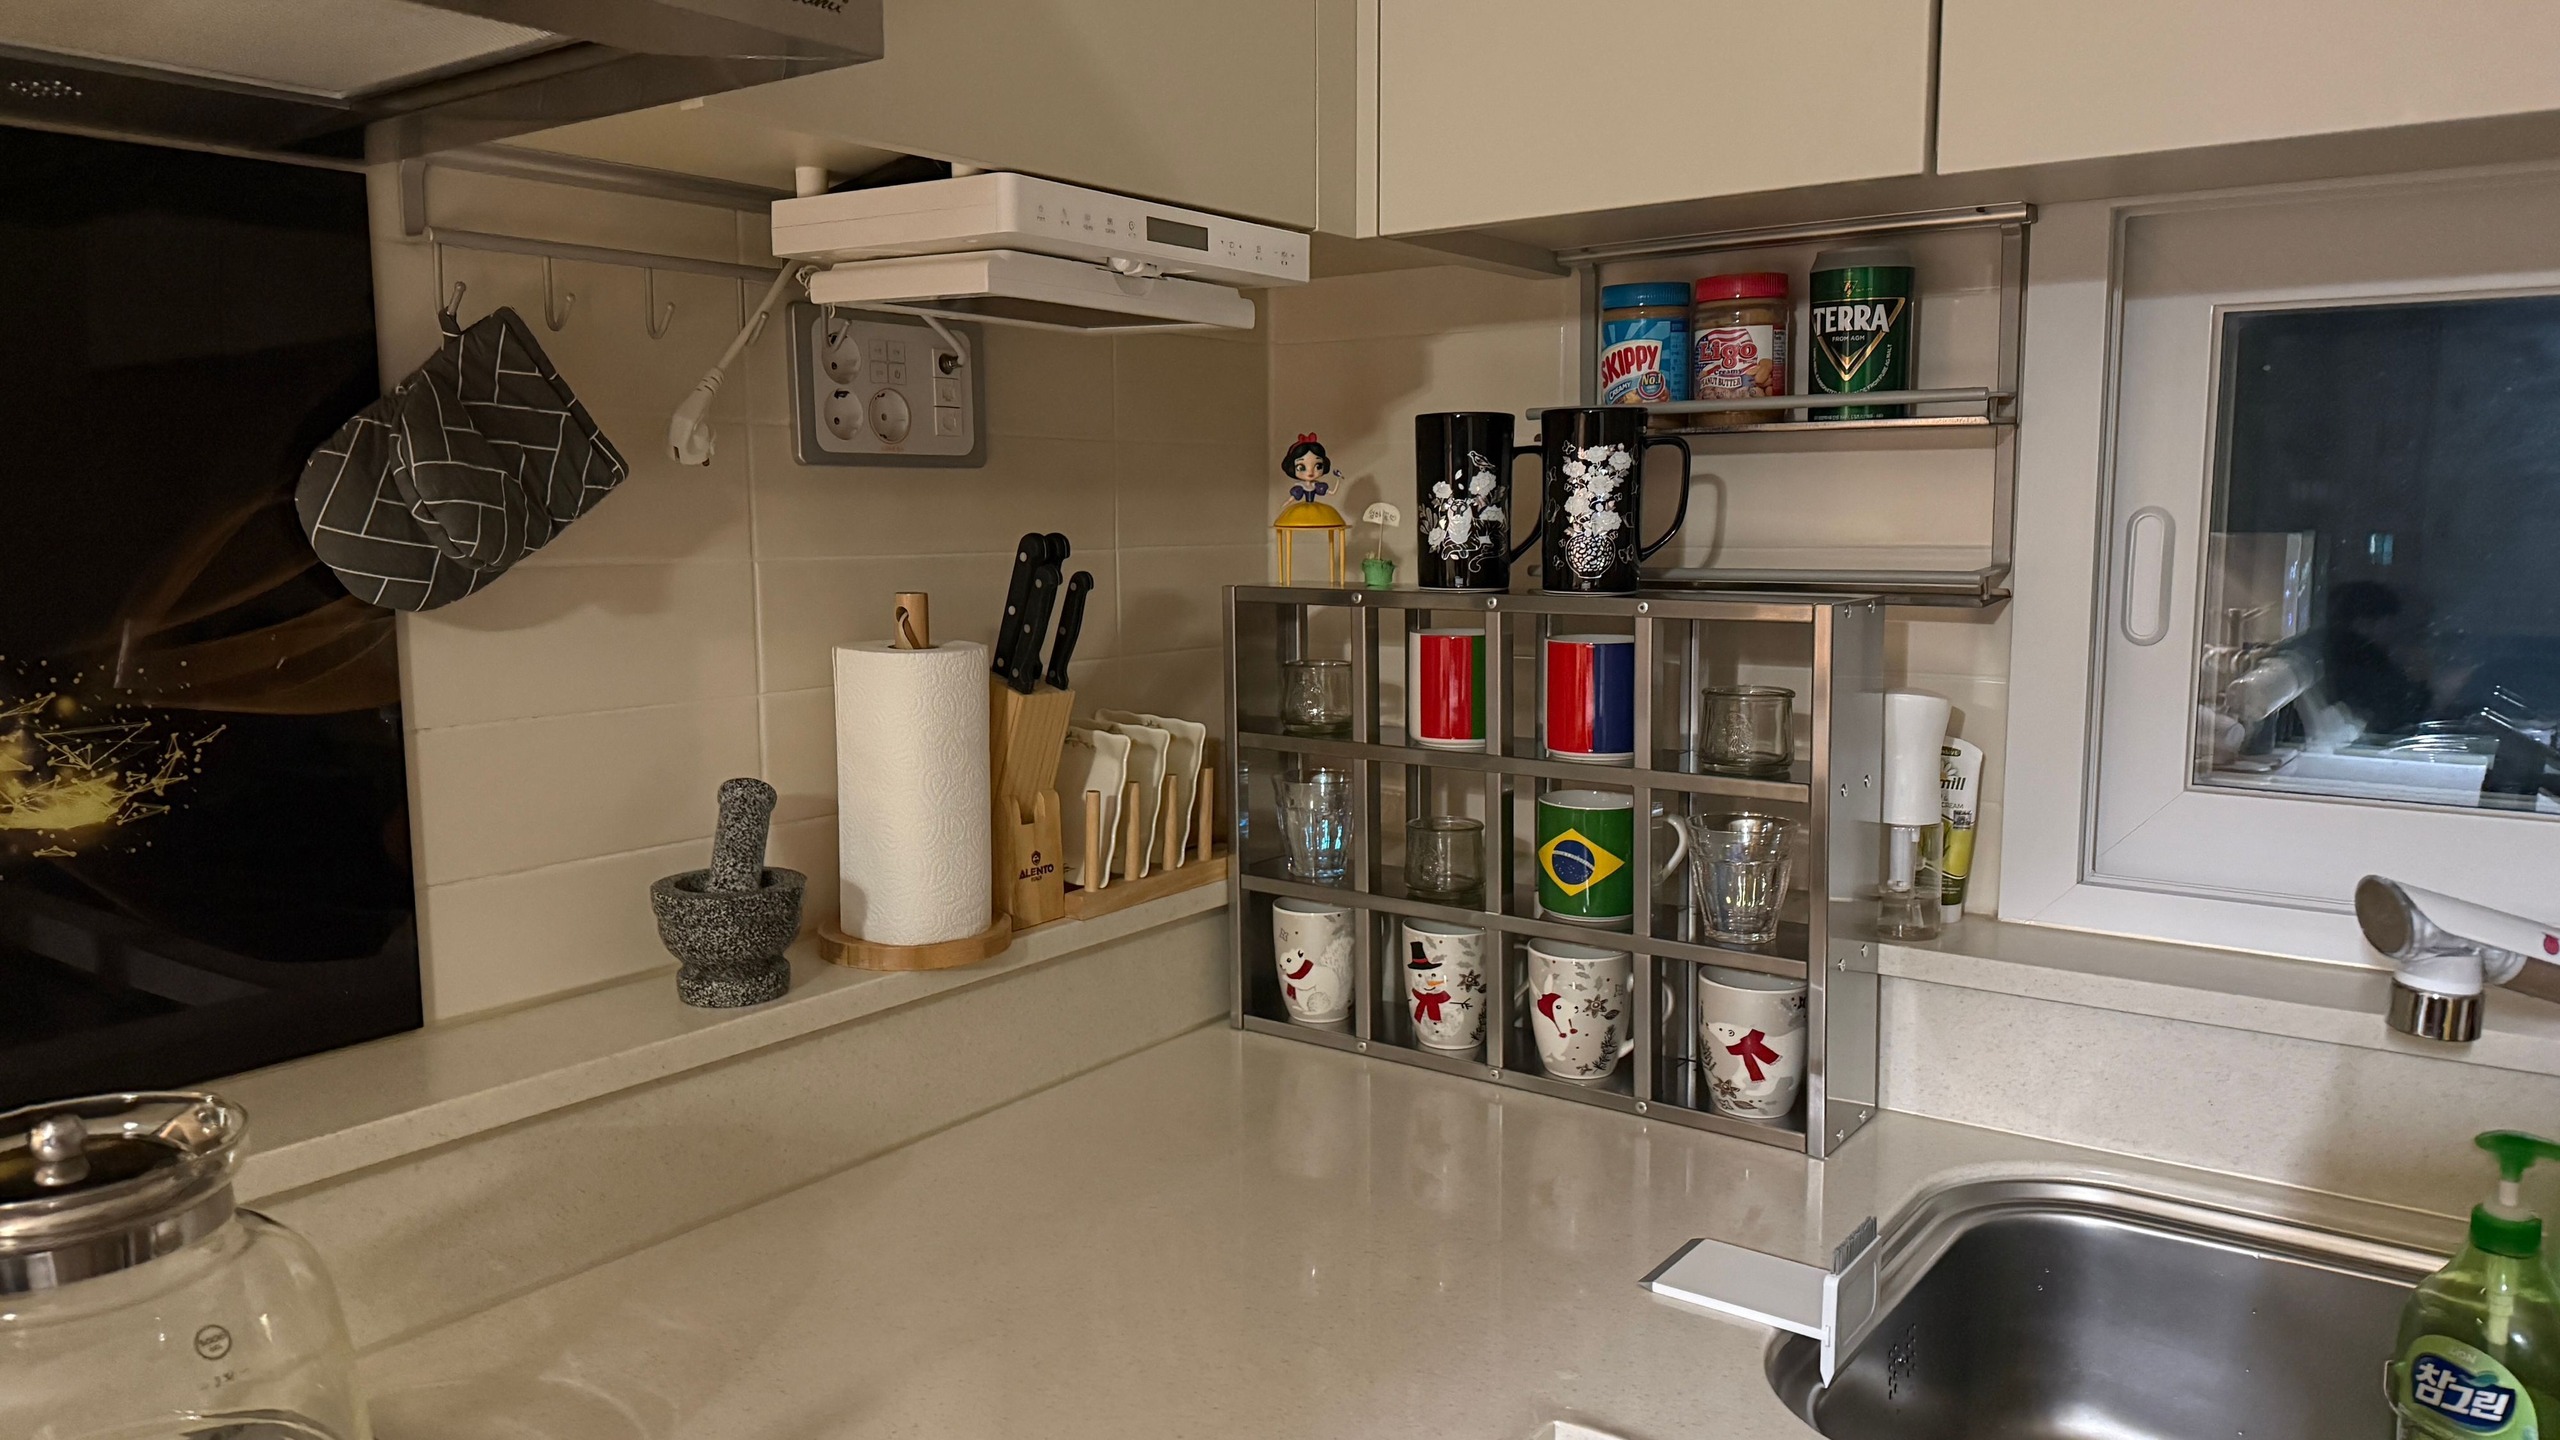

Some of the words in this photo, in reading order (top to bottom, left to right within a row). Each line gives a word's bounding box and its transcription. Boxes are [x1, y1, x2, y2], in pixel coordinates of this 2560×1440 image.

[1813, 303, 1890, 336] TERRA
[1700, 339, 1758, 370] Ligo
[1601, 345, 1659, 389] SKIPPY
[1641, 374, 1662, 387] No.1
[1718, 378, 1741, 387] BUTTER
[1609, 381, 1632, 400] CREAMY
[1940, 777, 1967, 791] mill
[1019, 864, 1054, 880] ALENTO
[2415, 1362, 2510, 1422] 참그린
